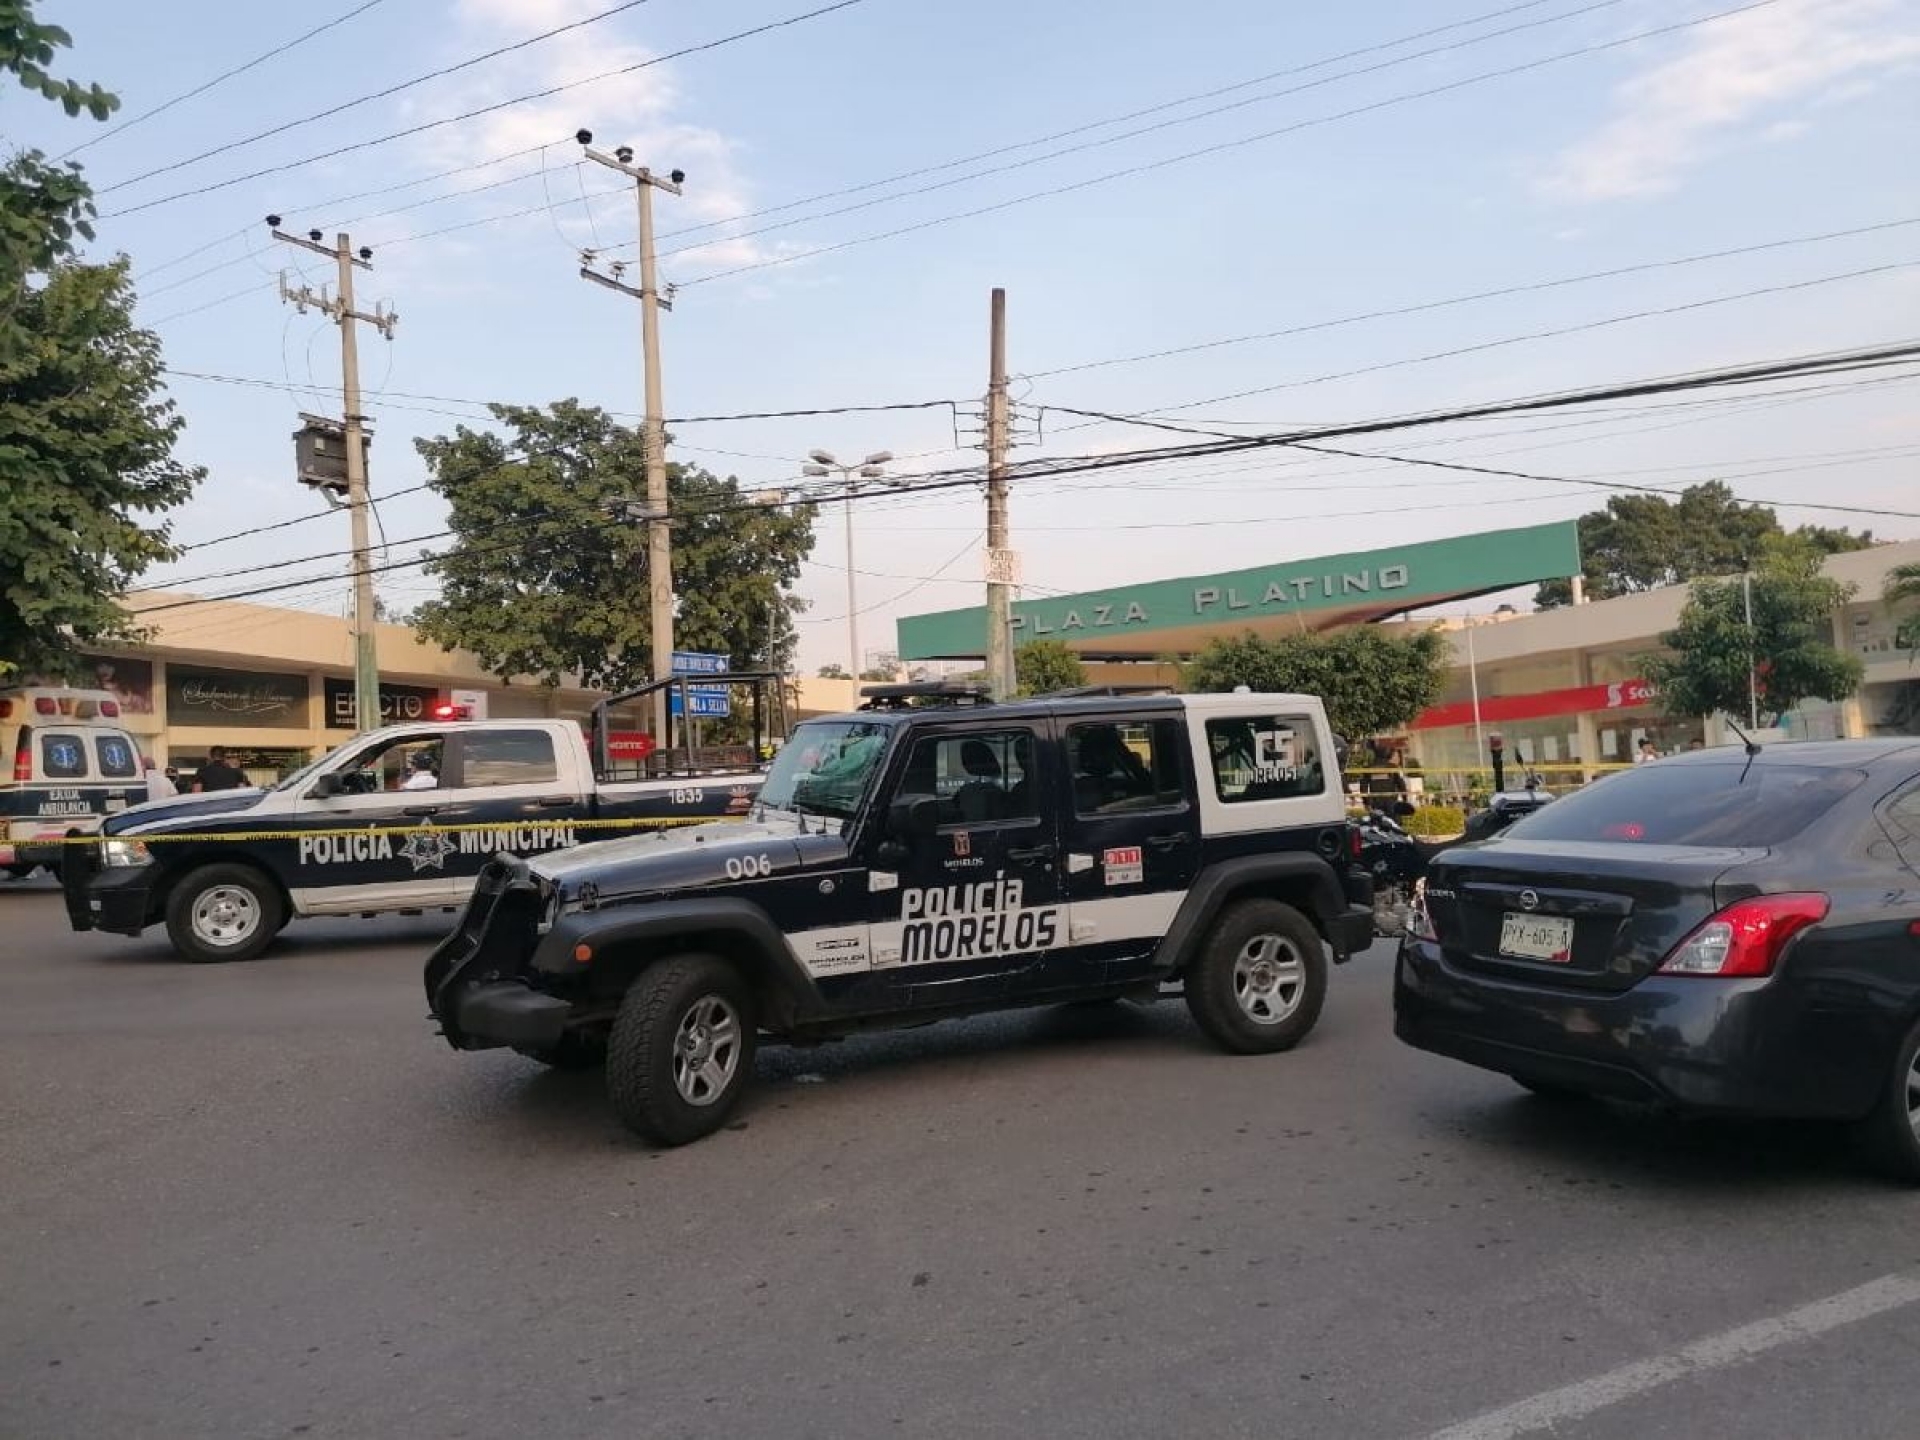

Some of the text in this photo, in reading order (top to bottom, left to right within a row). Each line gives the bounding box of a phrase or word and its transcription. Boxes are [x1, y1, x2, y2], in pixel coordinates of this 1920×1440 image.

[1009, 565, 1408, 636] PLAZA PLATINO
[335, 692, 422, 718] EFCTO
[1255, 730, 1295, 768] C5
[300, 819, 579, 865] POLICÍA MUNICIPAL
[1106, 850, 1138, 864] 911
[726, 853, 771, 879] 006
[901, 910, 1056, 962] MORELOS
